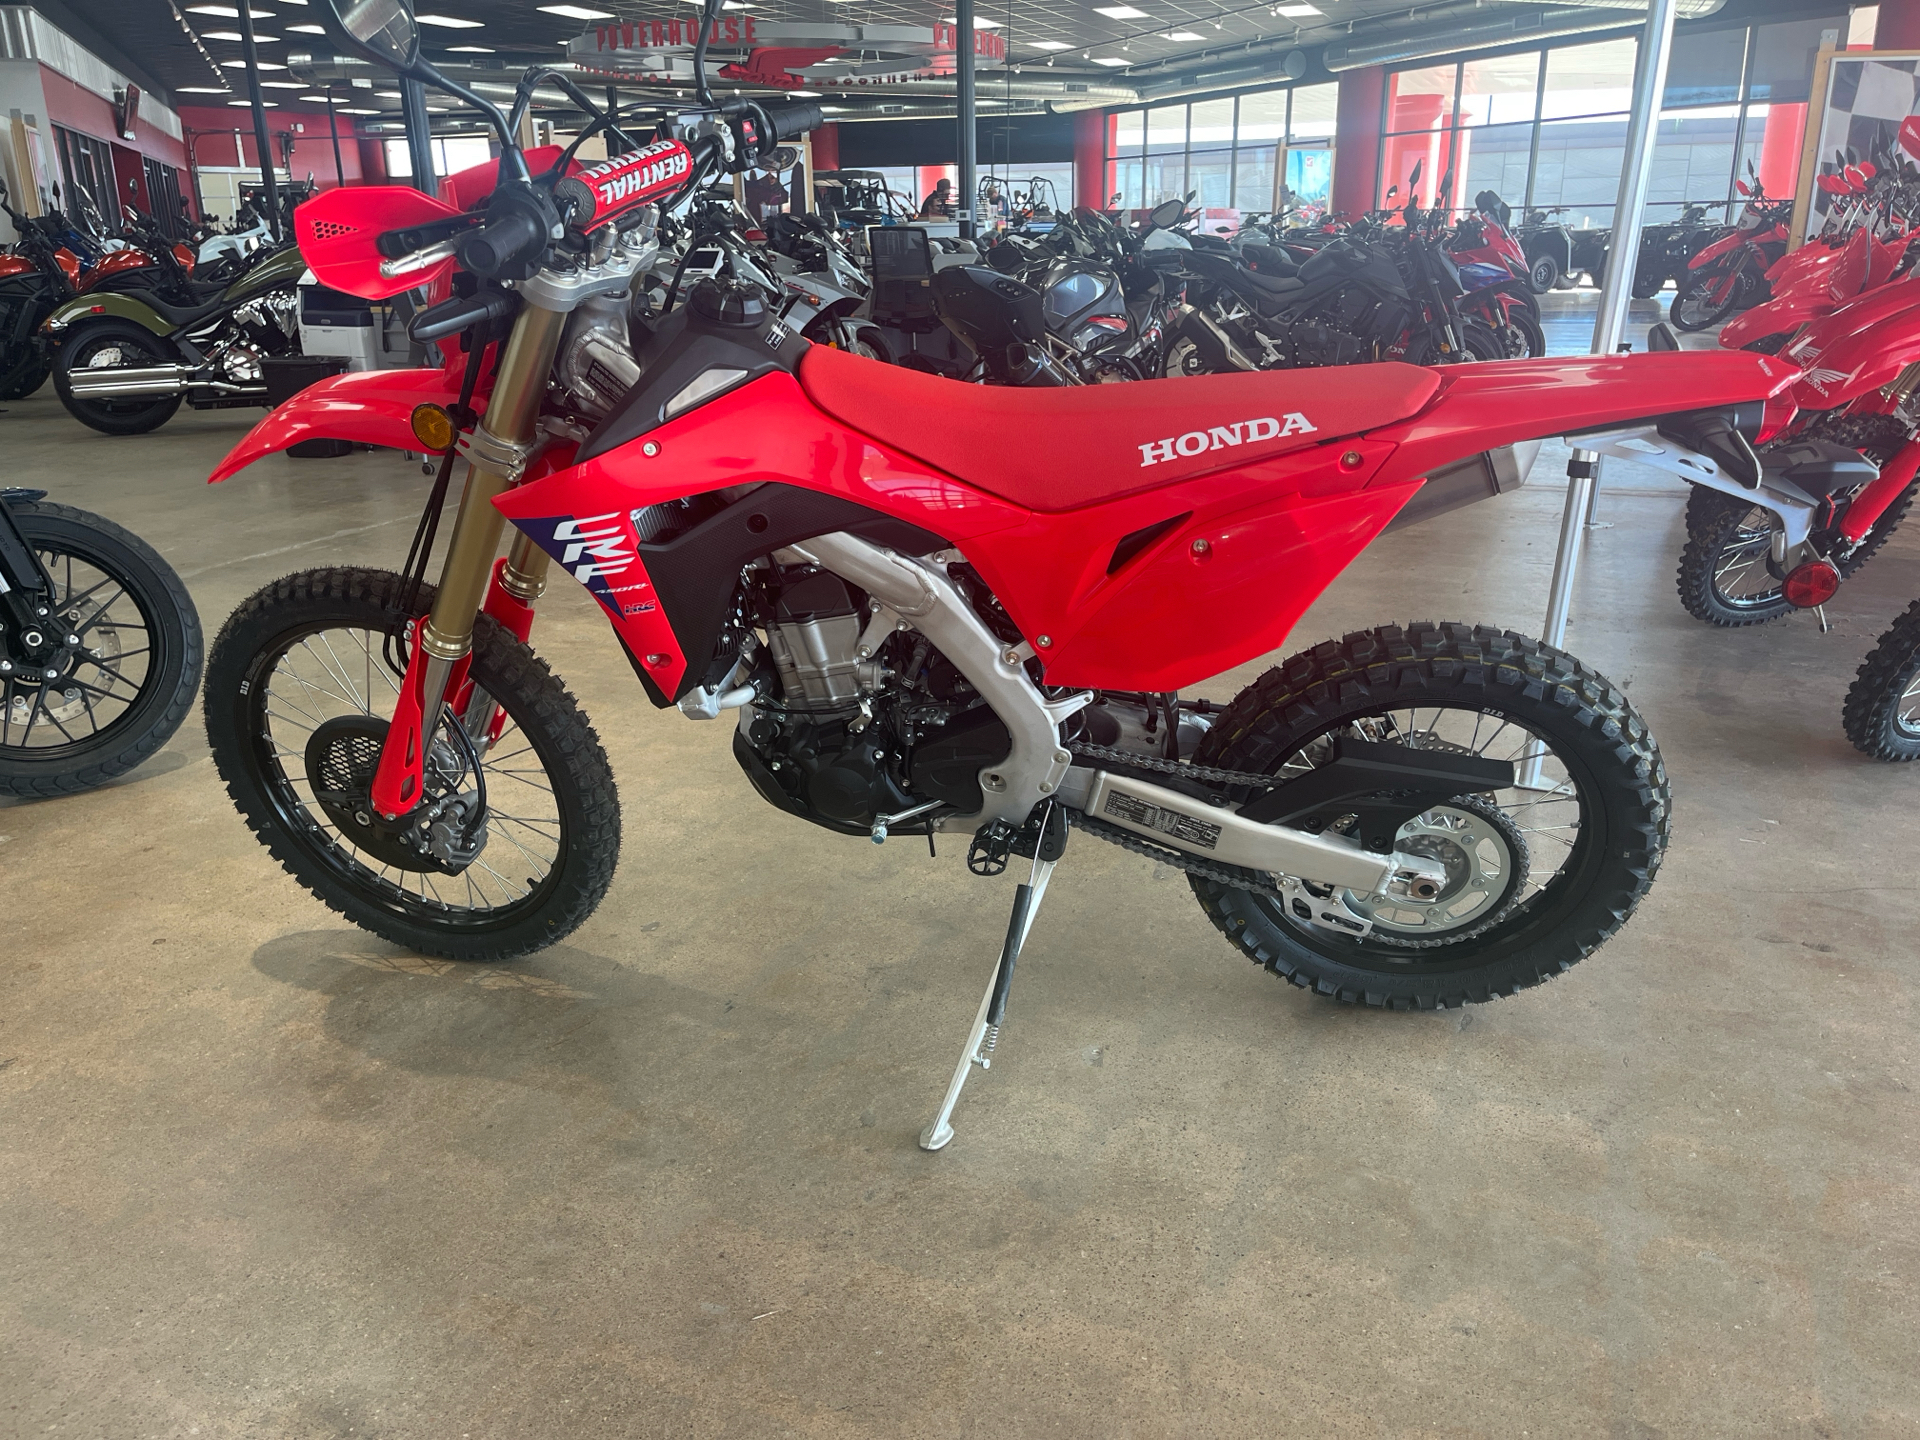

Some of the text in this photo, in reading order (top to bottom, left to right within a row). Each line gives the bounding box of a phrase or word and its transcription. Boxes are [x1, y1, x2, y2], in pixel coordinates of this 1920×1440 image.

[599, 153, 687, 205] RENTHAL
[1803, 376, 1829, 398] HONDA
[1138, 412, 1317, 467] HONDA
[553, 511, 635, 585] CRF
[624, 600, 655, 614] HRC
